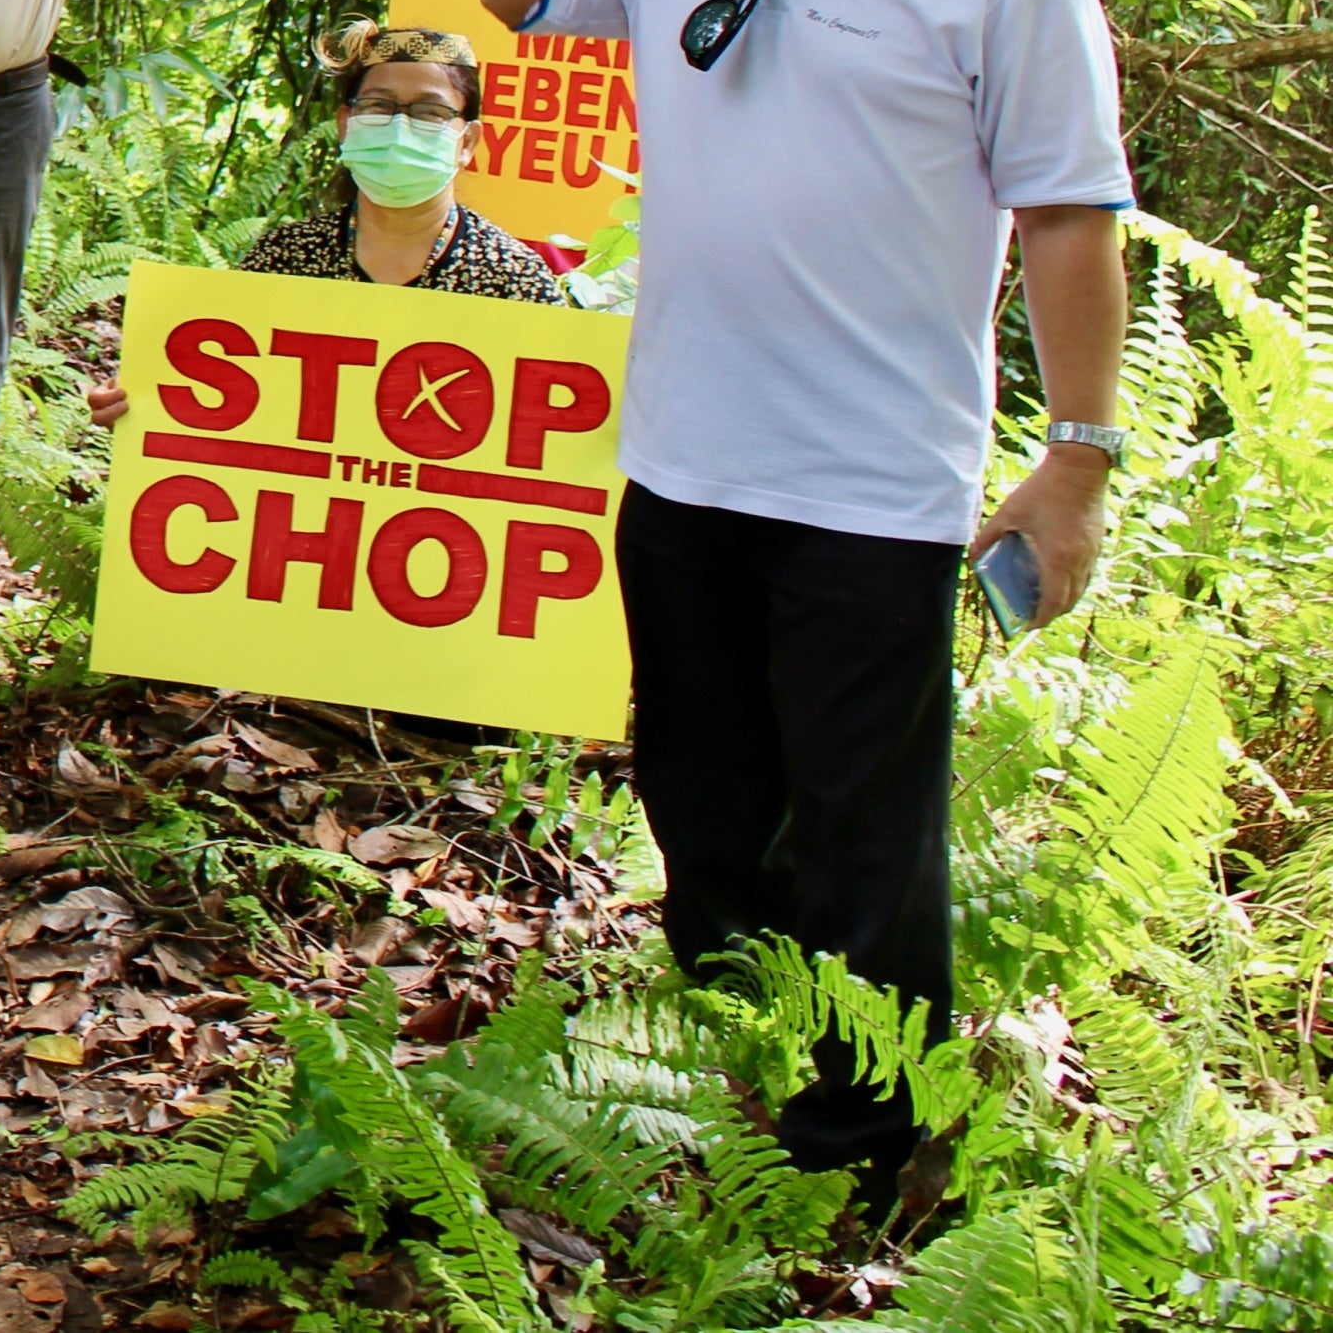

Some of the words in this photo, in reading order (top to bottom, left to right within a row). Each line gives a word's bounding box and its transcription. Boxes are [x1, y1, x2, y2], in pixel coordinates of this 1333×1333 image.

[477, 62, 638, 133] EBEN
[157, 318, 611, 471] STOP
[336, 454, 412, 489] THE
[130, 474, 604, 640] CHOP
